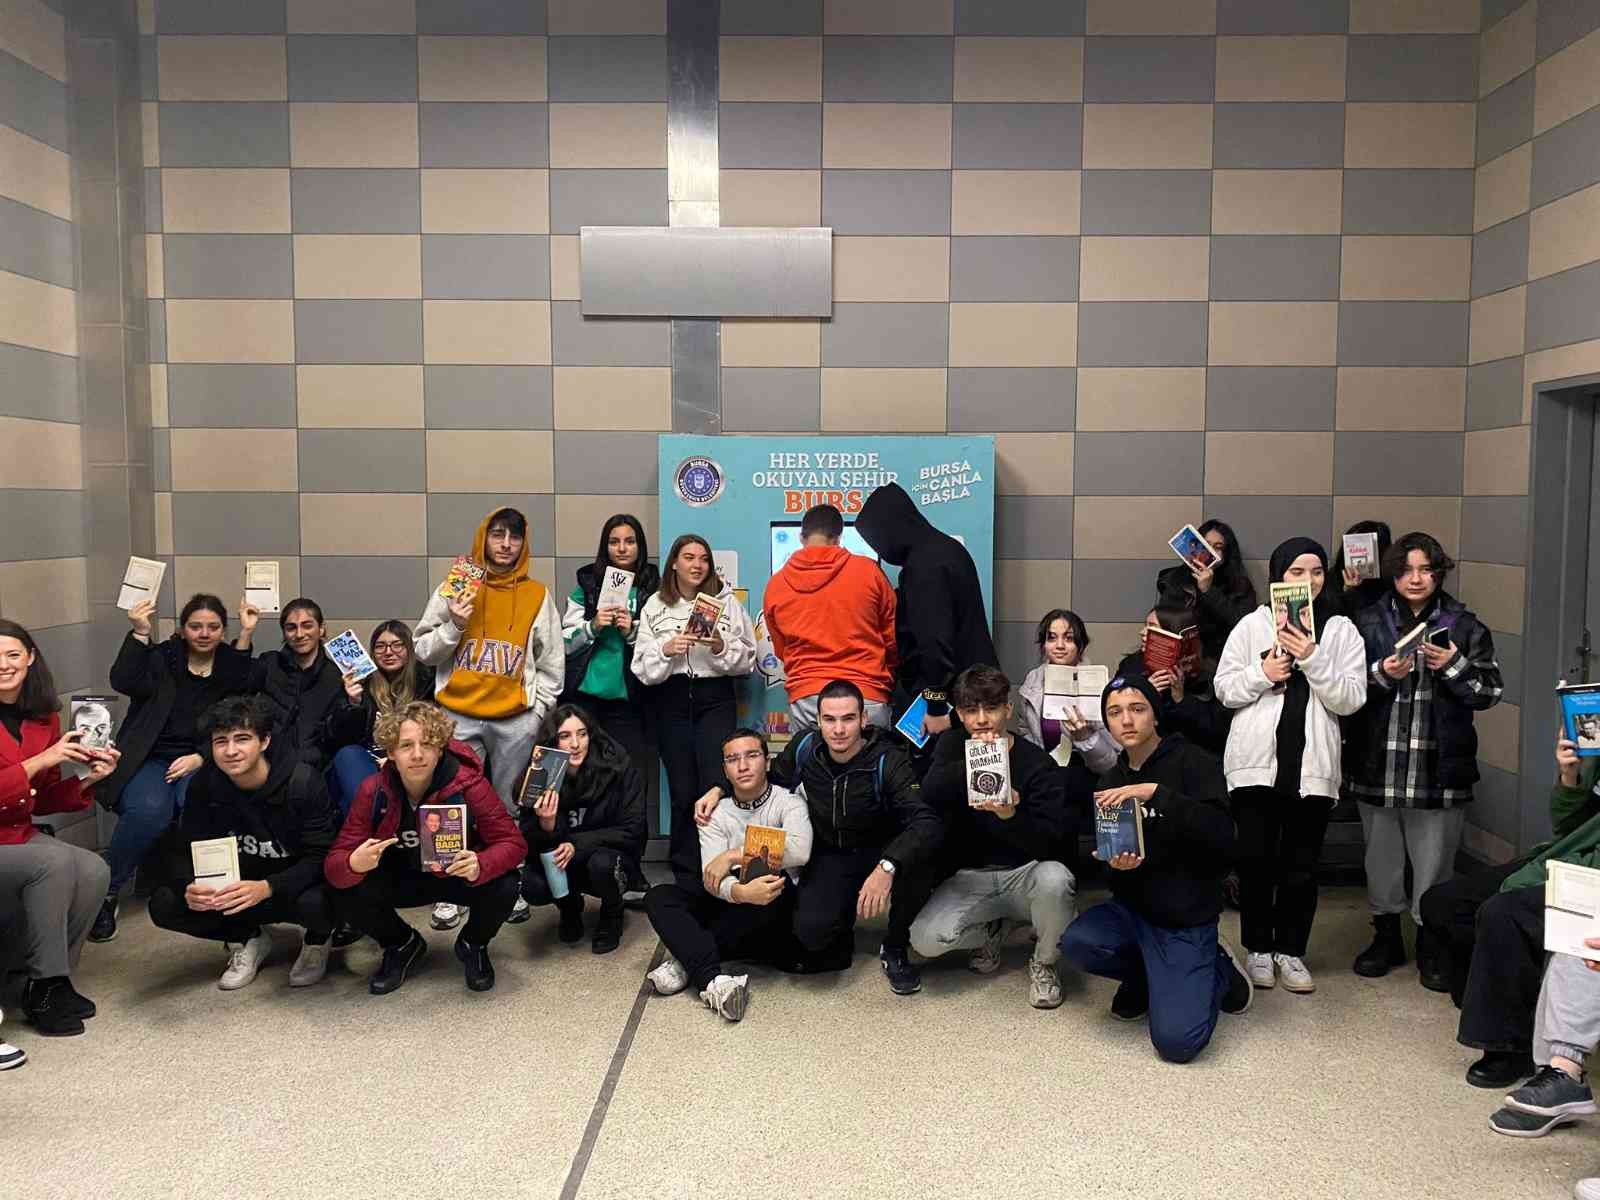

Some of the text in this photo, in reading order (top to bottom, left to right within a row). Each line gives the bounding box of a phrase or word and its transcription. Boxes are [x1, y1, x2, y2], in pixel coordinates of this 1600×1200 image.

[769, 453, 879, 469] HER YERDE
[920, 460, 972, 479] BURSA
[752, 467, 898, 492] OKUYAN ŞEHİR
[929, 471, 983, 491] CANLA
[784, 490, 875, 514] BURS
[920, 486, 971, 505] BAŞLA
